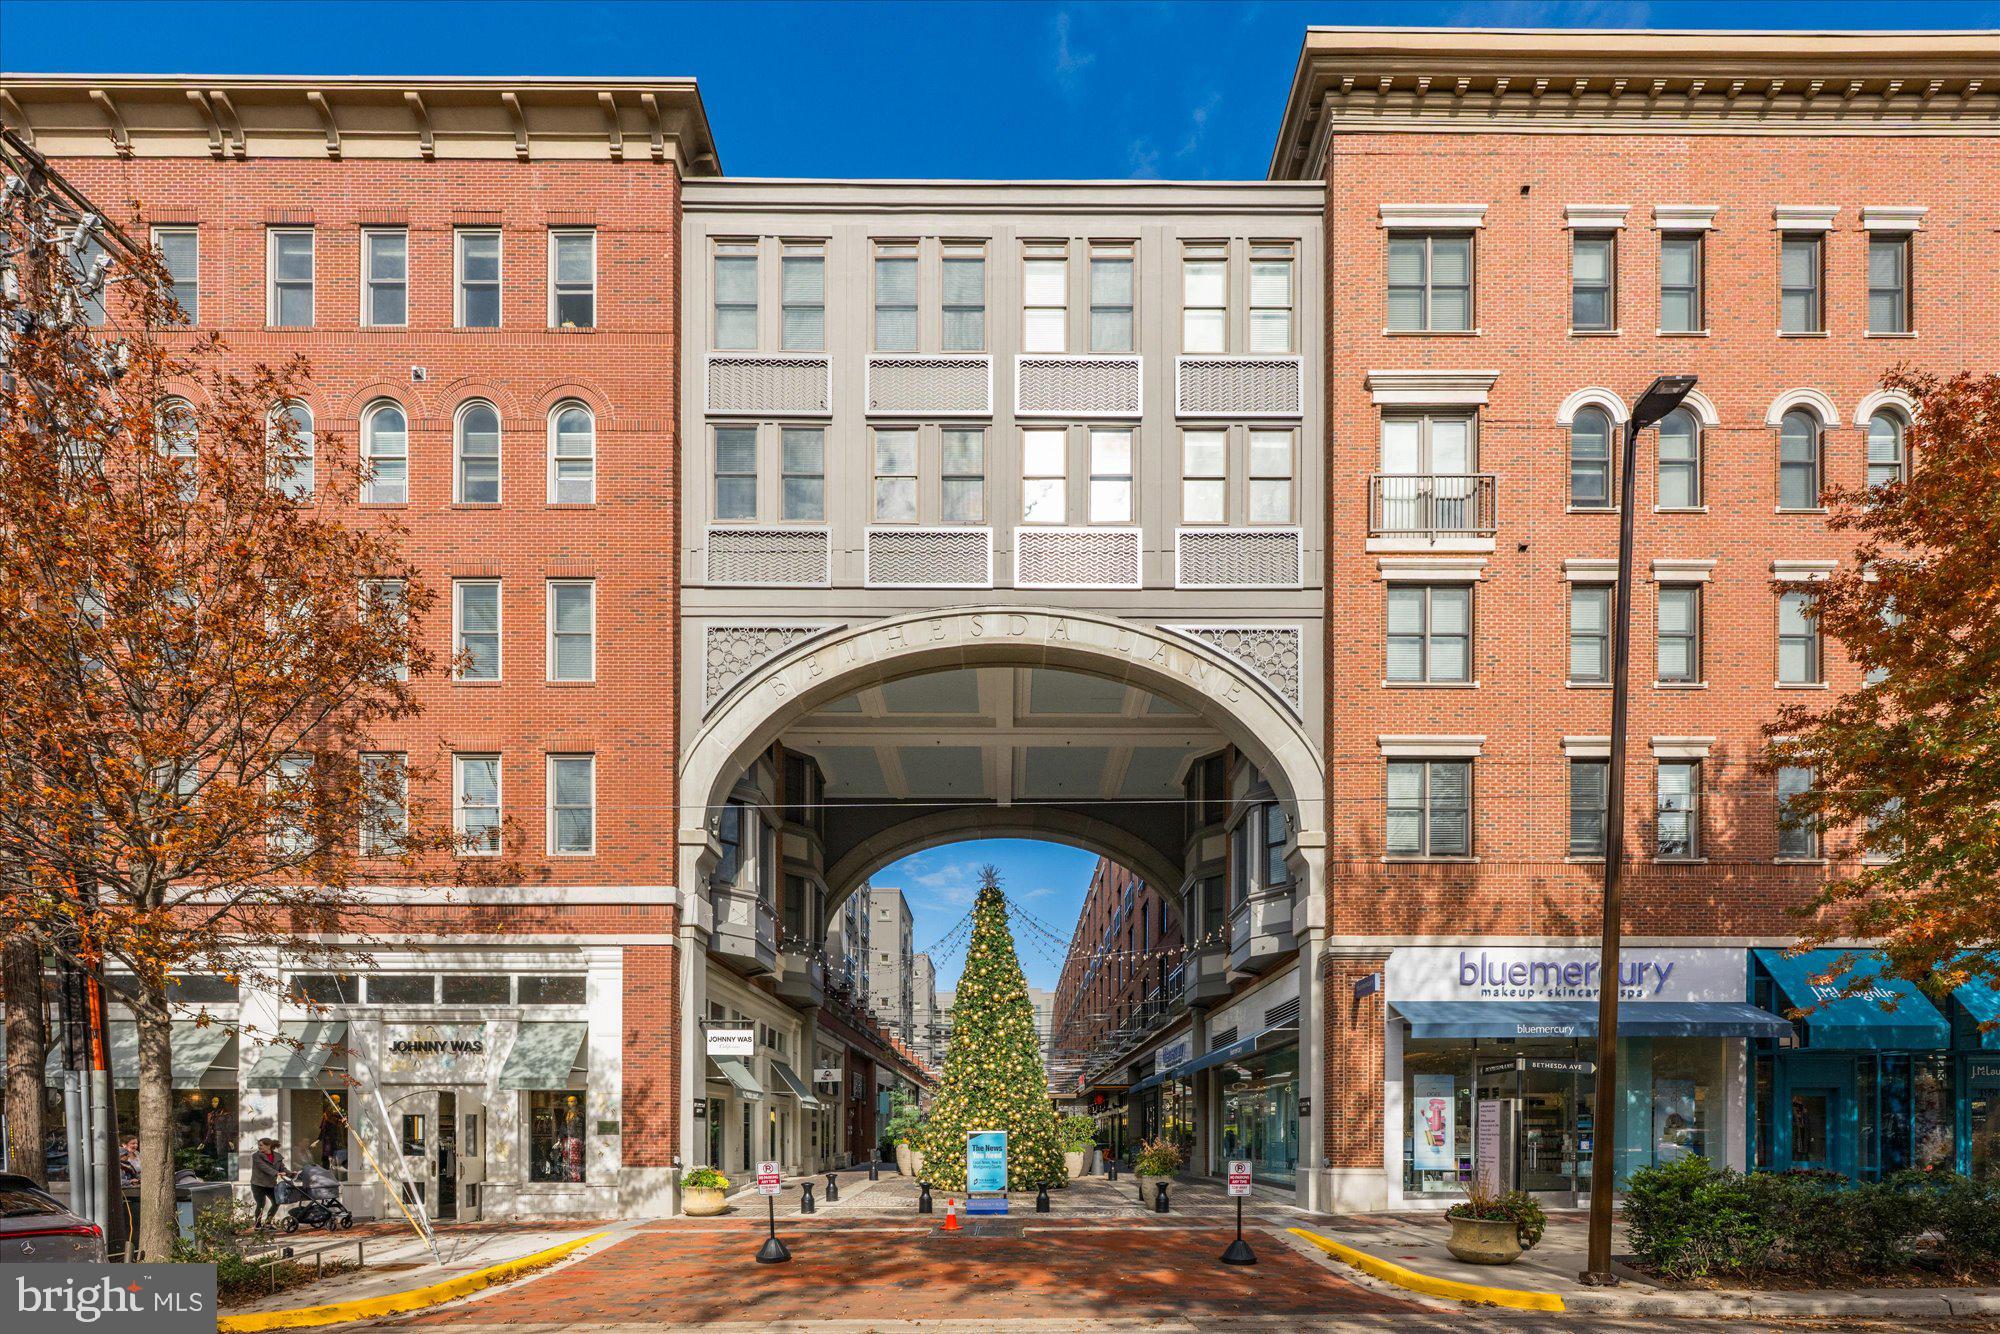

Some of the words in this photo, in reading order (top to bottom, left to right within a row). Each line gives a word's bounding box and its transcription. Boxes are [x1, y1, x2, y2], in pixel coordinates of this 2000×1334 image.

[769, 613, 1072, 701] BETHESDA
[1117, 628, 1243, 704] LANE
[1459, 951, 1674, 993] bluemerury
[1481, 986, 1534, 999] makeup
[1547, 986, 1600, 998] skincar
[1620, 989, 1644, 999] spa
[1517, 1024, 1575, 1036] bluemercury
[389, 1040, 448, 1053] JOHNNY
[450, 1040, 483, 1053] WAS
[1532, 1062, 1567, 1071] BETHESDA
